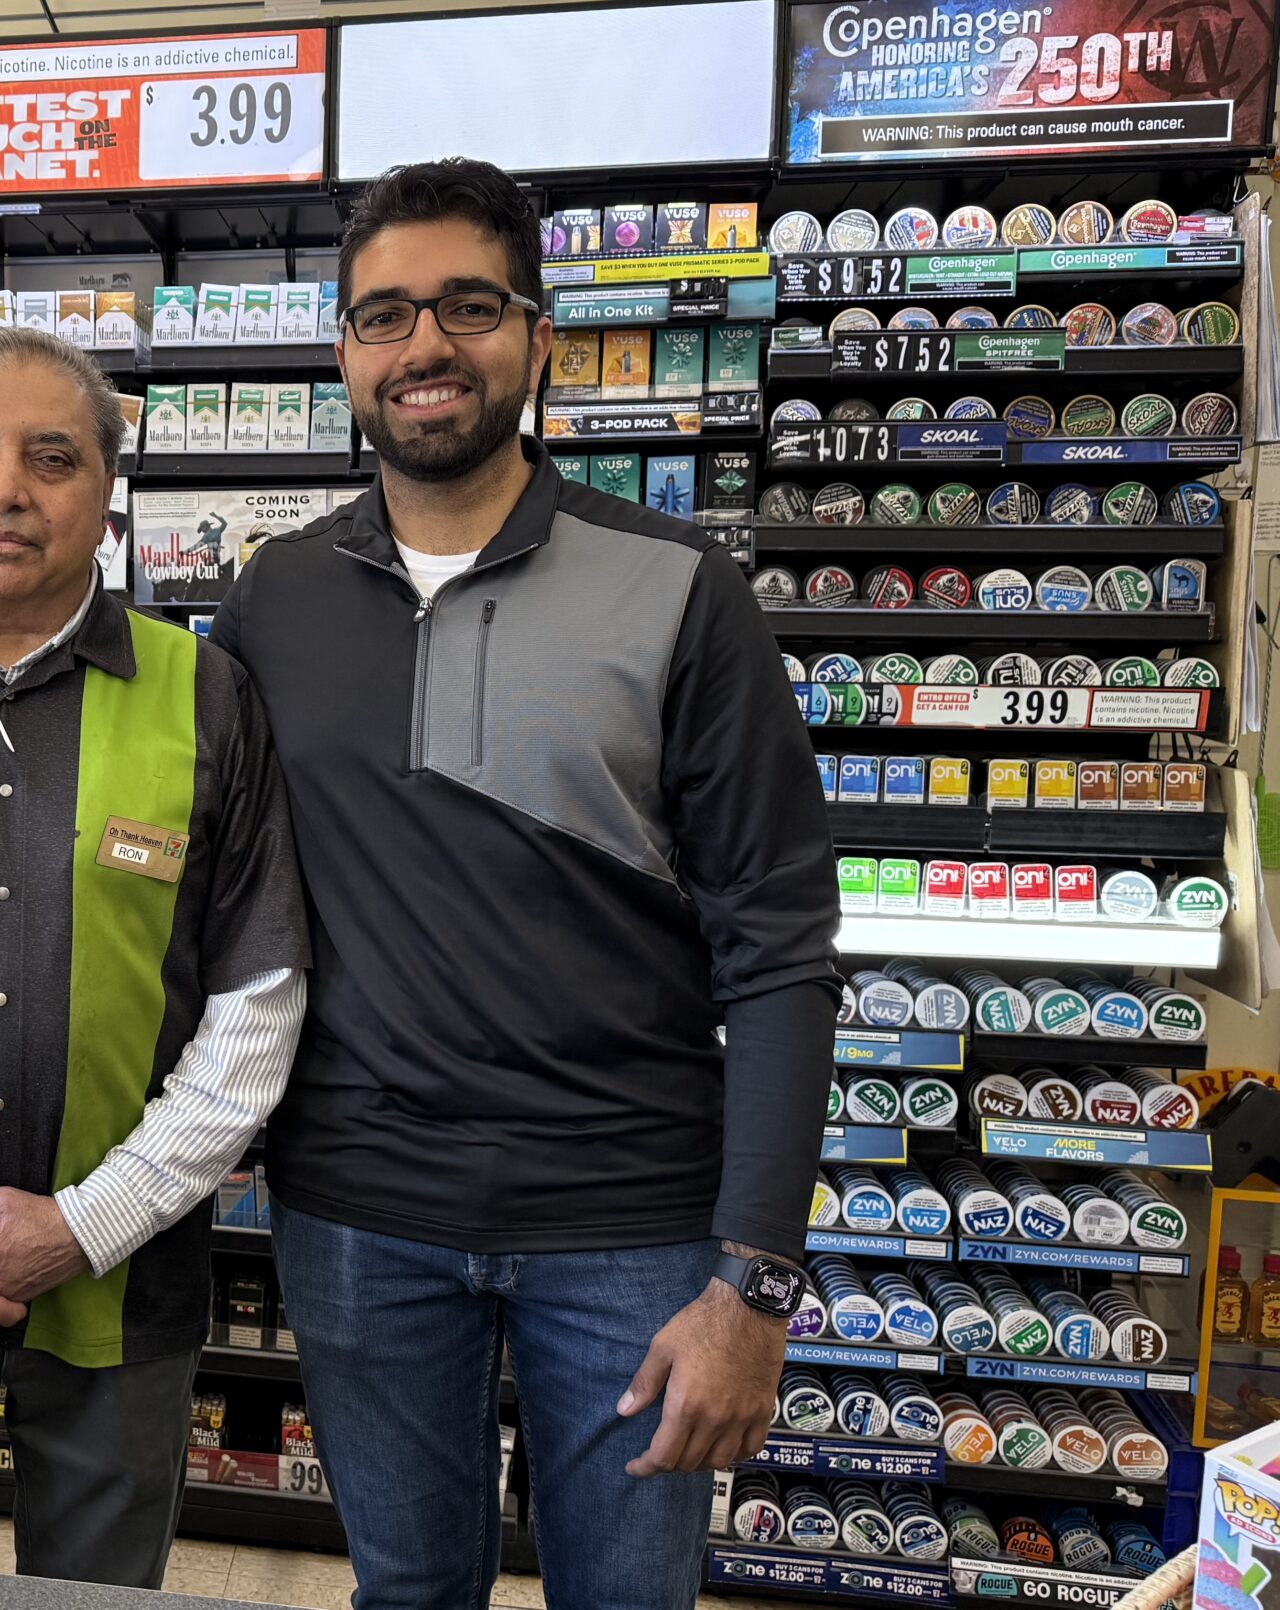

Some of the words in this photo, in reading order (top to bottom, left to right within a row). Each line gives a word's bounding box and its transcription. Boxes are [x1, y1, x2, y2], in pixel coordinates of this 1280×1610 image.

[823, 5, 1041, 57] Copenhagen
[54, 56, 112, 71] Nicotine
[117, 54, 128, 68] is
[133, 55, 150, 67] an
[155, 50, 219, 66] addictive
[224, 44, 294, 62] chemical.
[872, 40, 970, 66] HONORING
[838, 65, 989, 101] AMERICA'S
[145, 85, 154, 106] $
[190, 81, 292, 147] 3.99
[79, 119, 109, 134] ON
[863, 127, 933, 142] WARNING:
[936, 125, 963, 139] This
[968, 124, 1016, 140] product
[1021, 123, 1044, 136] can
[1048, 121, 1087, 134] cause
[1091, 117, 1133, 132] mouth
[1138, 118, 1185, 131] cancer.
[74, 134, 117, 150] THE
[928, 256, 996, 272] Copenhagen
[1050, 250, 1134, 269] Copenhagen
[819, 259, 832, 294] $
[568, 307, 585, 319] All
[589, 306, 601, 318] in
[604, 305, 632, 318] One
[636, 305, 654, 317] Kit
[672, 304, 699, 312] SPECIAL
[155, 324, 190, 341] Marlboro
[875, 337, 888, 370] $
[985, 349, 1034, 357] SPITFREE
[634, 418, 668, 429] PACK
[920, 429, 980, 443] SKOAL
[1062, 446, 1126, 460] SKOAL
[245, 495, 311, 506] COMING
[255, 508, 301, 519] SOON
[144, 562, 195, 584] Cowboy
[195, 563, 220, 580] Cut
[919, 693, 946, 702] INTRO
[946, 693, 969, 702] OFFER
[1100, 695, 1143, 704] WARNING:
[1144, 696, 1160, 705] This
[1161, 696, 1192, 707] product
[916, 703, 929, 711] GET
[929, 703, 935, 711] A
[972, 688, 979, 700] $
[1001, 689, 1069, 725] 3.99
[1094, 705, 1127, 714] contains
[1128, 706, 1161, 714] nicotine.
[1163, 706, 1195, 715] Nicotine
[1117, 715, 1152, 724] addictive
[1153, 716, 1189, 725] chemical.
[109, 827, 119, 836] Oh
[120, 829, 140, 841] Thank
[140, 835, 163, 848] Heaven
[118, 846, 144, 861] RON
[1181, 890, 1217, 904] ZYN
[1104, 1002, 1139, 1020] ZYN
[1162, 1004, 1196, 1022] ZYN
[992, 1135, 1027, 1148] VELO
[1053, 1137, 1096, 1150] MORE
[1045, 1148, 1105, 1161] FLAVORS
[853, 1199, 885, 1212] ZYN
[806, 1234, 900, 1250] .COM/REWARDS
[966, 1243, 1007, 1260] ZYN
[1014, 1249, 1134, 1267] ZYN.COM/REWARDS
[894, 1311, 933, 1333] VELO
[975, 1360, 1015, 1377] ZYN
[1022, 1366, 1141, 1385] ZYN.COM/REWARDS
[192, 1427, 220, 1438] Black
[196, 1437, 220, 1448] Mild
[773, 1453, 808, 1466] $12.00
[881, 1456, 894, 1464] BUY
[1120, 1450, 1162, 1461] VELO
[875, 1461, 913, 1475] $12.00
[1010, 1539, 1050, 1557] ROGUE
[1123, 1547, 1164, 1568] ROGUE
[960, 1560, 988, 1569] WARNING:
[1003, 1565, 1026, 1574] product
[1027, 1567, 1050, 1576] contains
[1050, 1570, 1074, 1579] nicotine.
[1075, 1573, 1098, 1581] Nicotine
[980, 1577, 1014, 1590] ROGUE
[1023, 1580, 1051, 1598] GO
[1057, 1585, 1119, 1606] ROGUE
